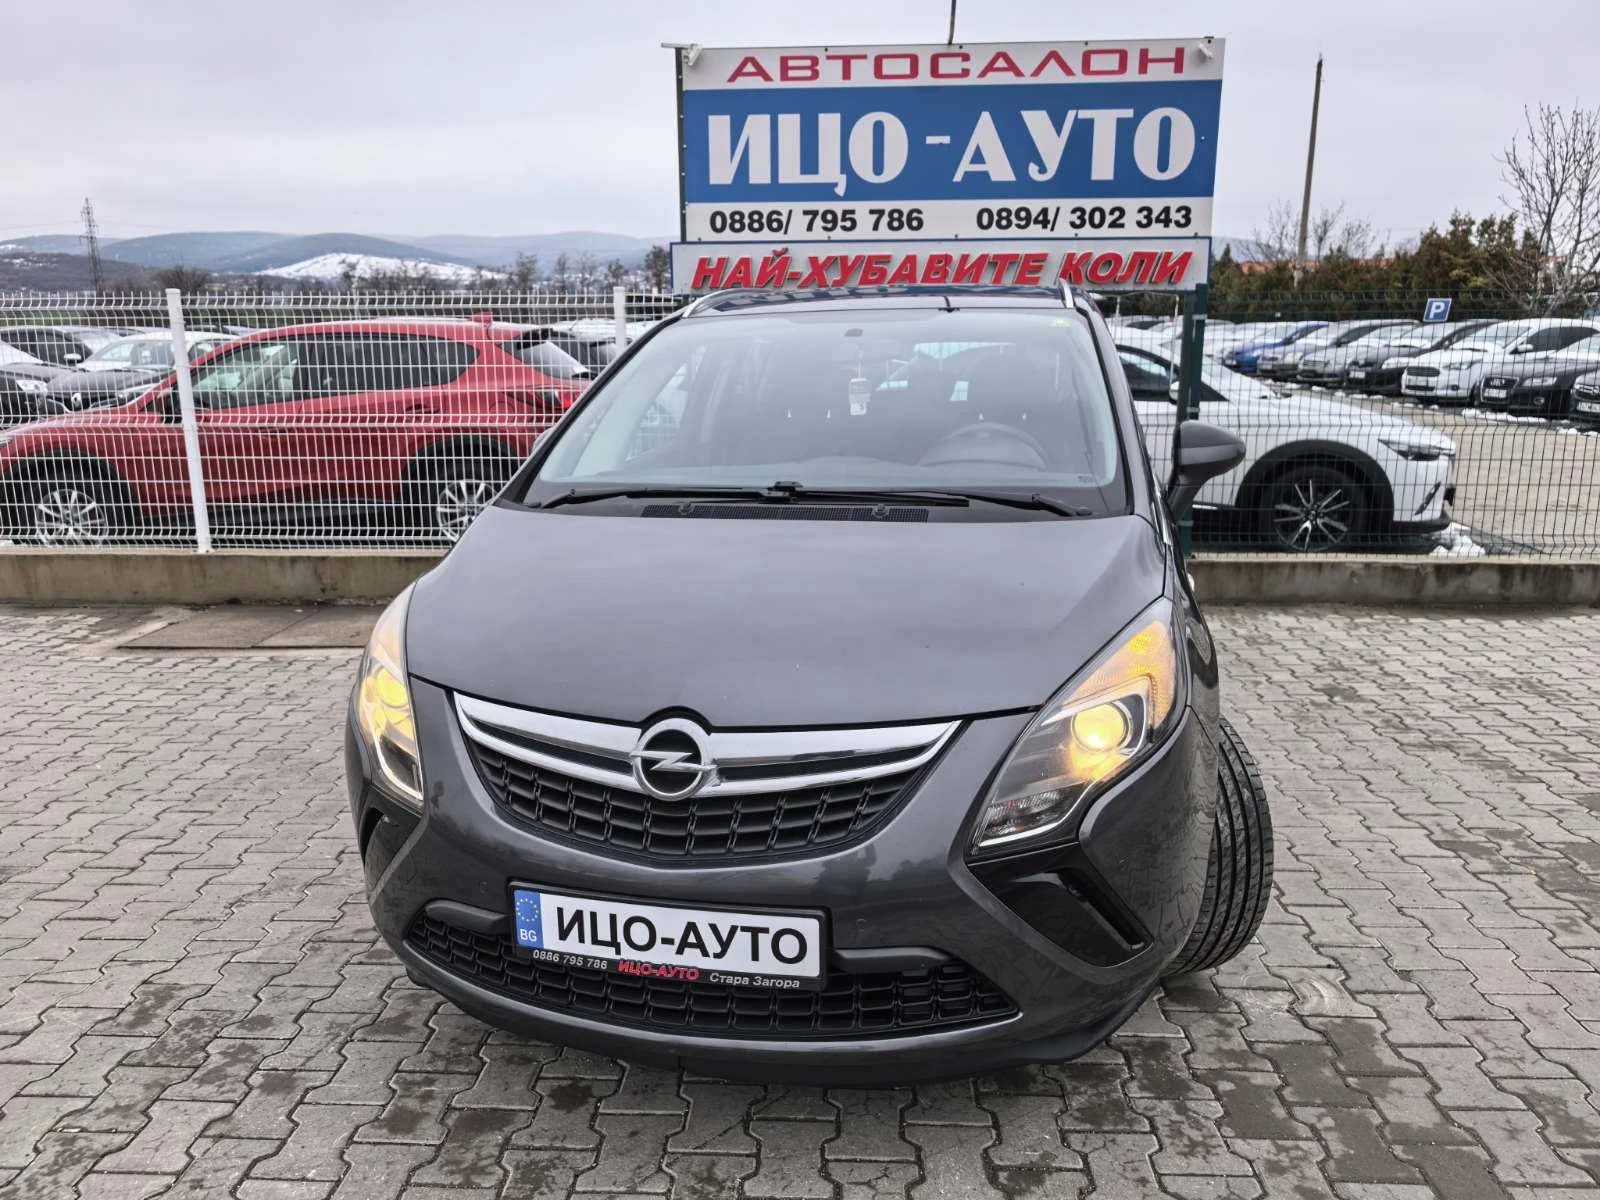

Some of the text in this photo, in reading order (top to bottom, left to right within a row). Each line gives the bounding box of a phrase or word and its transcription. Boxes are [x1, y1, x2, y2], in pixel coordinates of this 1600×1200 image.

[727, 47, 1185, 83] АВТОСАЛОН
[709, 208, 924, 235] 0886/ 795 786
[976, 205, 1192, 232] 0894/ 302 343
[690, 247, 1194, 289] НАЙ-ХУБАВИТЕ КОЛИ
[1429, 301, 1445, 320] P
[519, 929, 537, 943] BG
[556, 906, 808, 965] ИЦО-АУТО
[532, 949, 801, 989] 0886 795 786 ИЦО-АУТО Стара Загора
